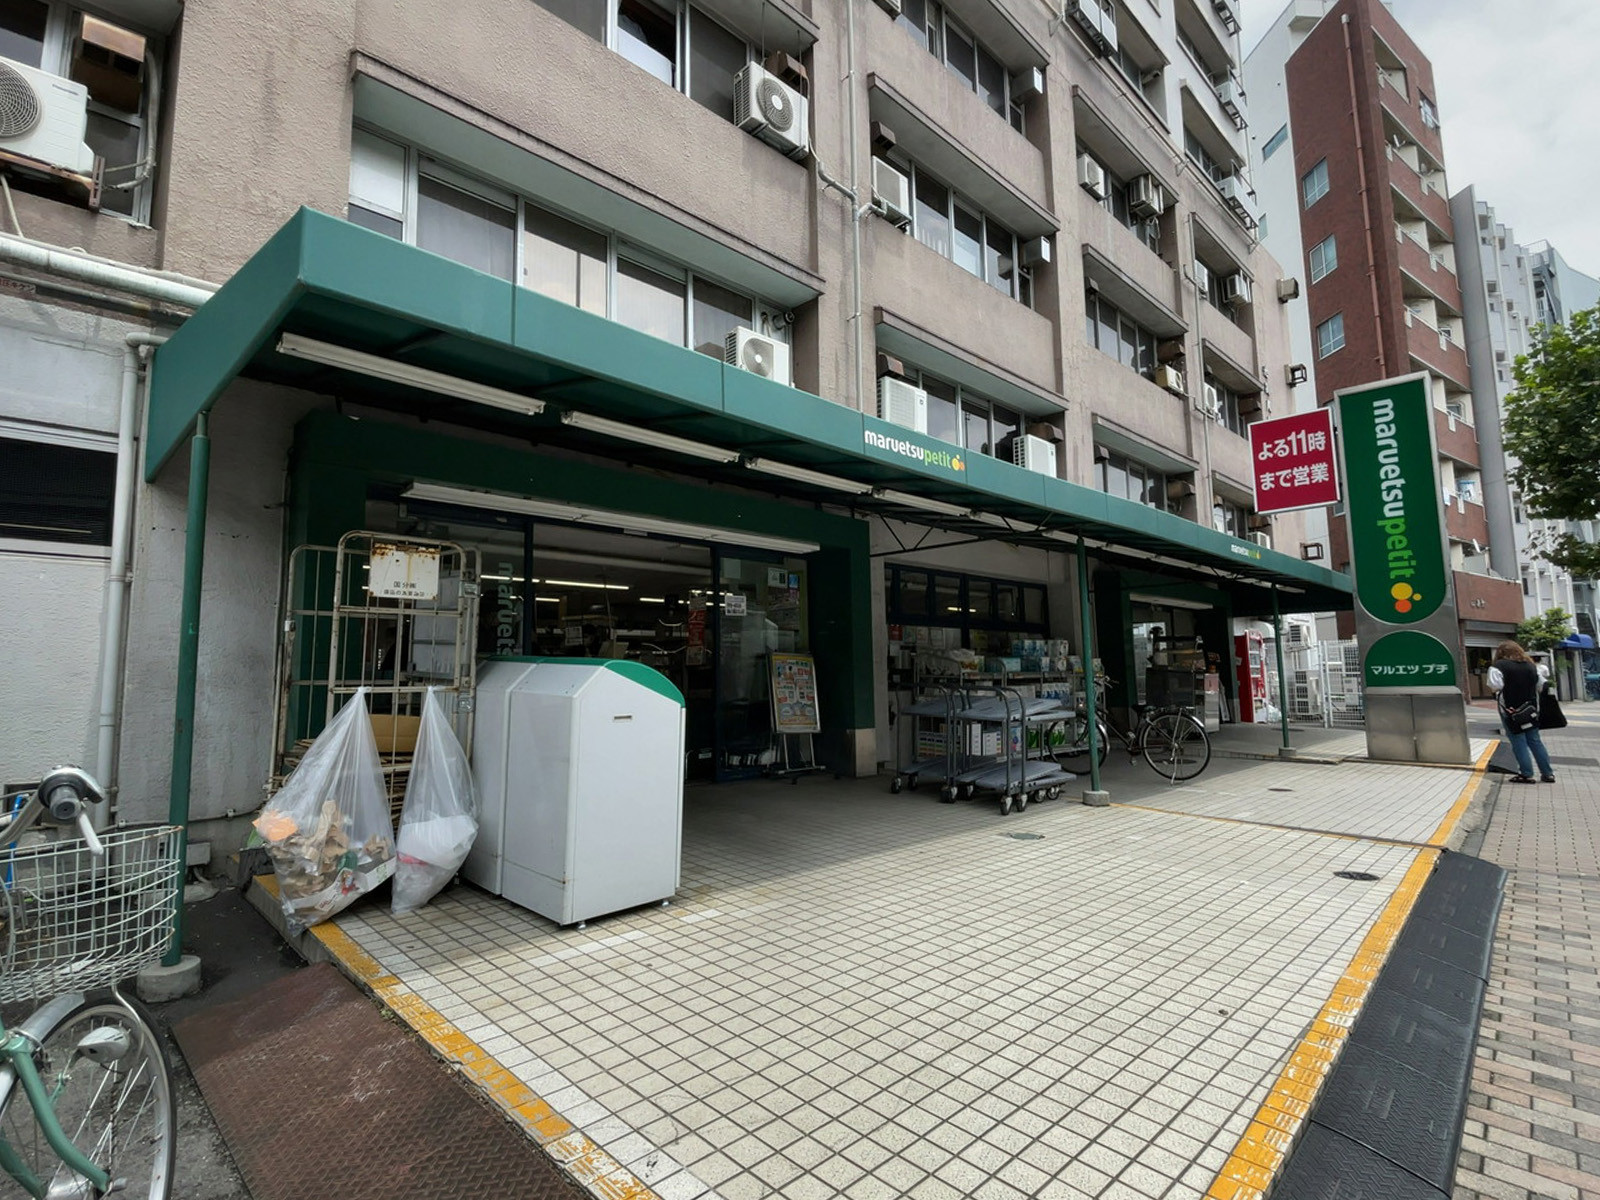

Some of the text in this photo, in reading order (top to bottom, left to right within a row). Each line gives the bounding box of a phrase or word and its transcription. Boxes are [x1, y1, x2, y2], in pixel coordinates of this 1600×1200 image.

[1258, 429, 1326, 460] よる11時
[1260, 462, 1329, 491] まで営業
[1370, 663, 1449, 675] マルエツ プチ
